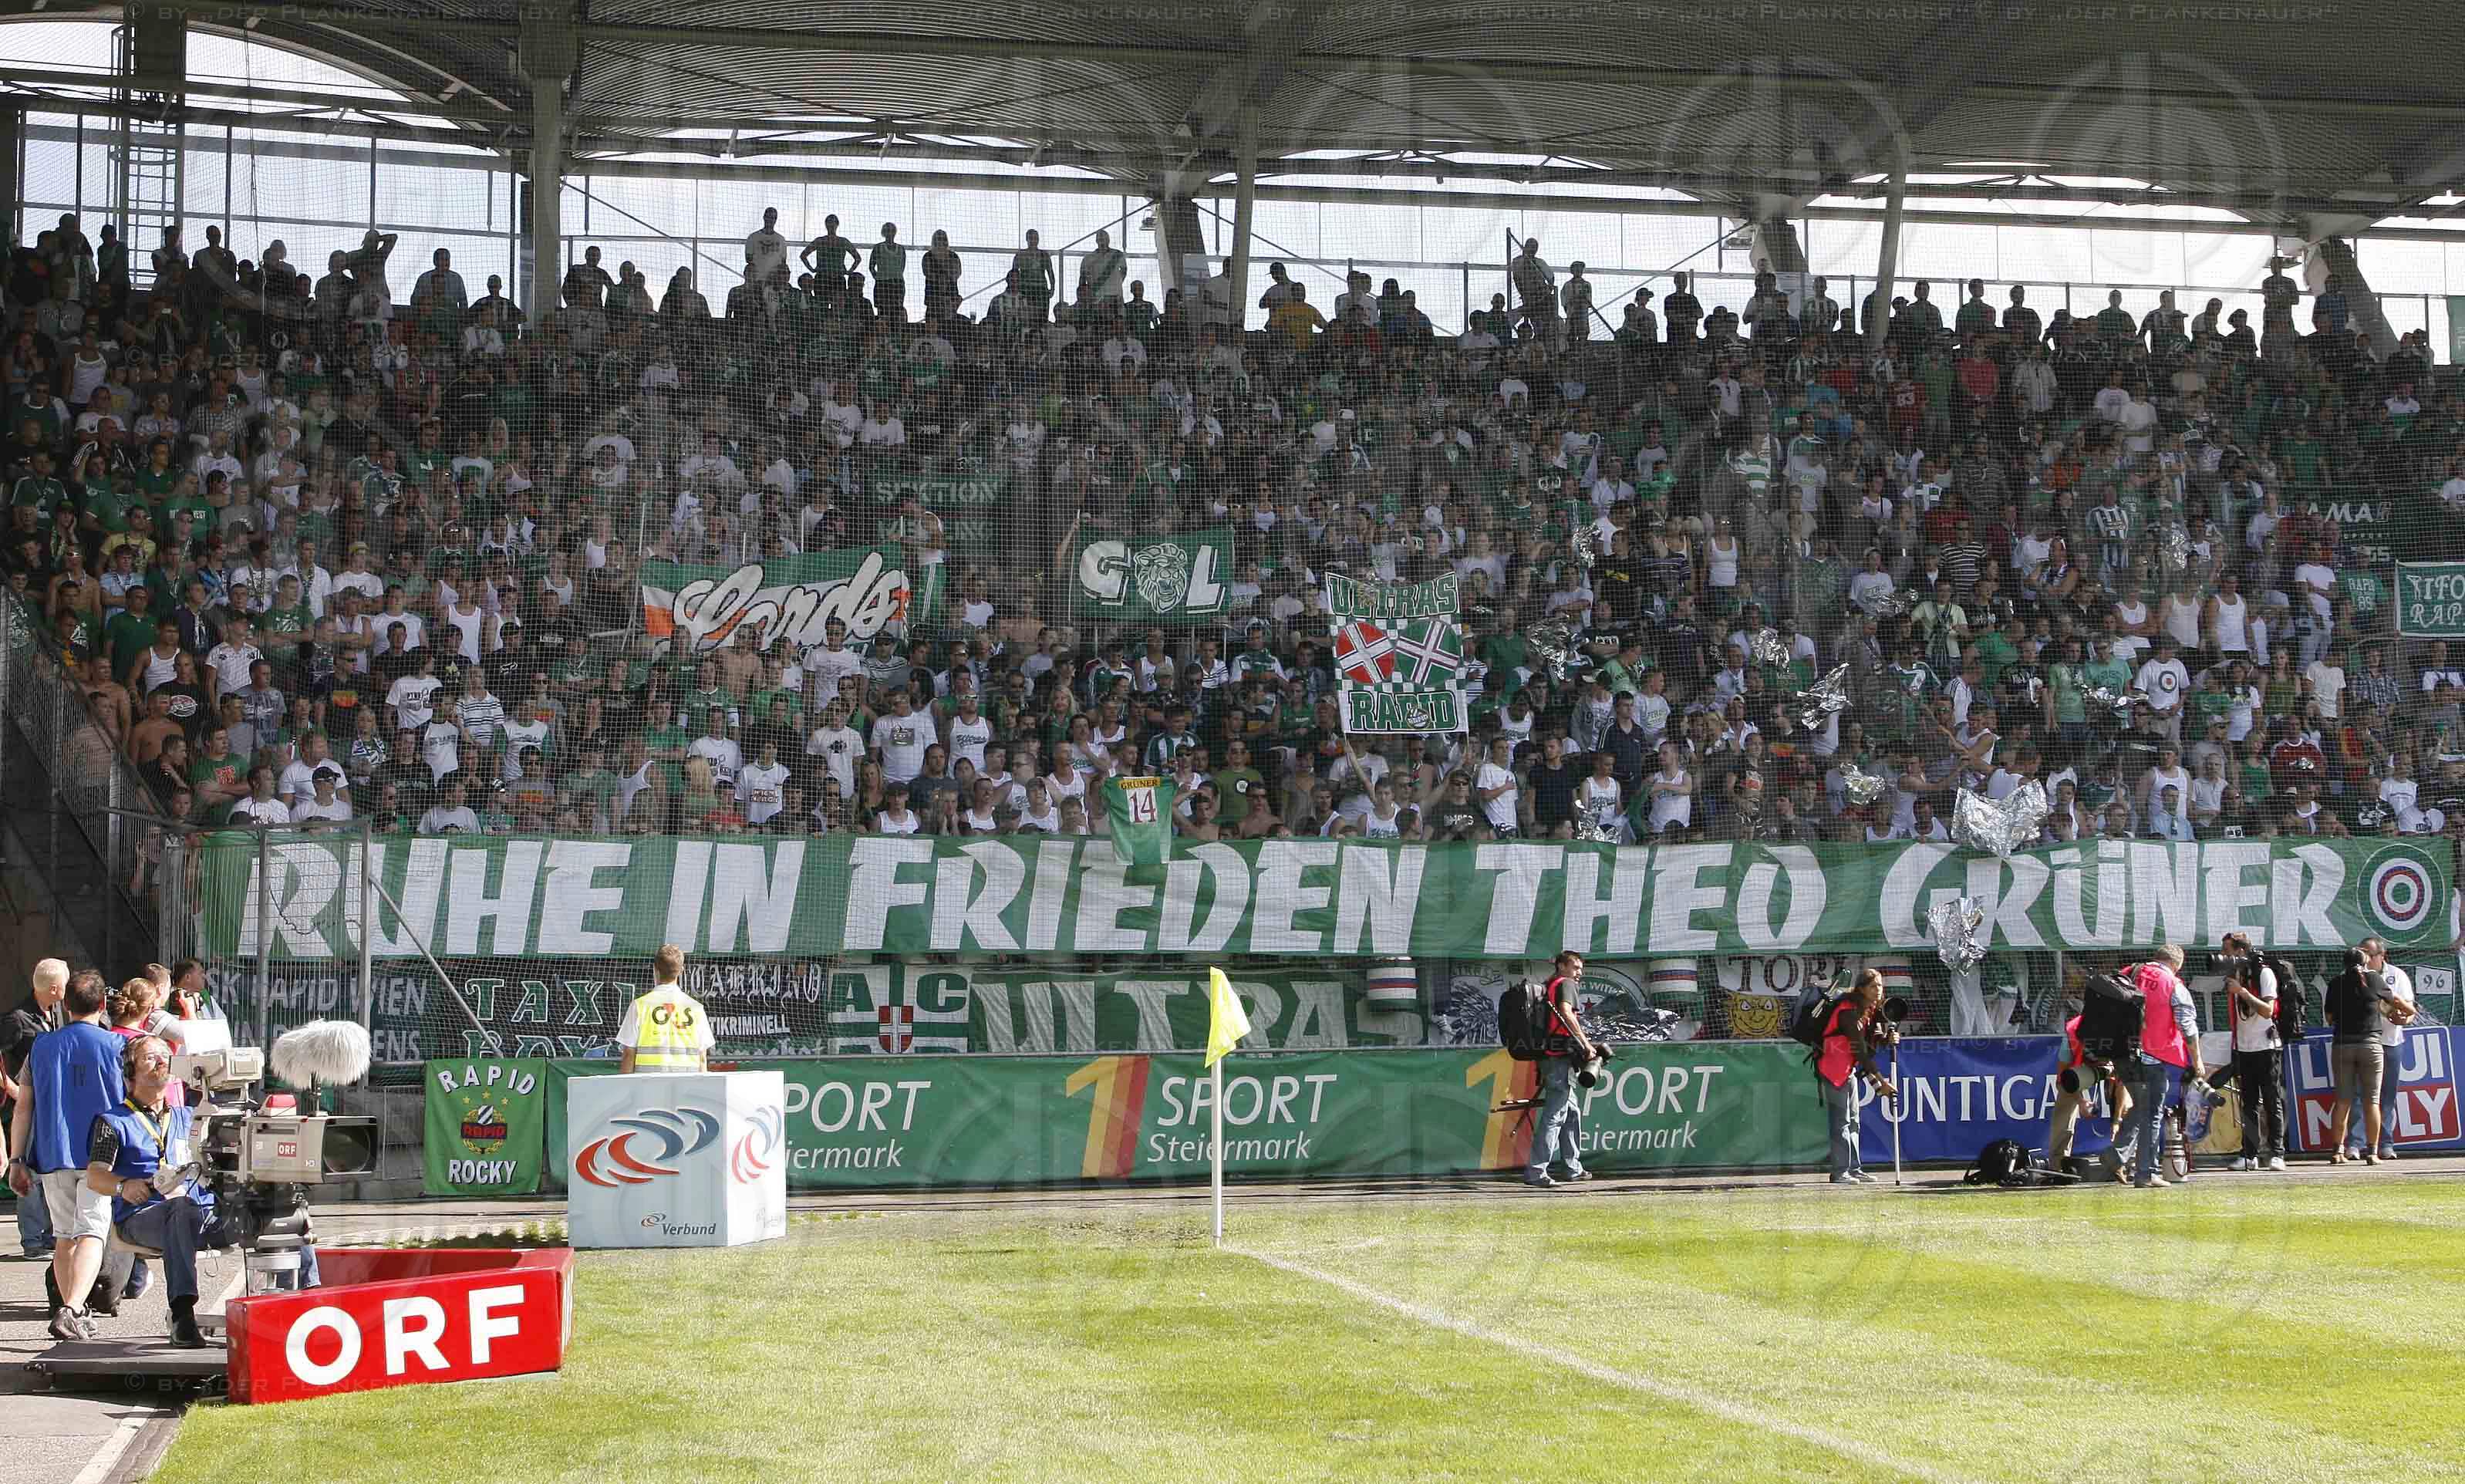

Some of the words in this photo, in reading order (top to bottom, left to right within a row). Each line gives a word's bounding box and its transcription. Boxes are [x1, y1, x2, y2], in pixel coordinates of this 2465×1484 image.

[1329, 576, 1458, 618] ULTRAS
[2410, 603, 2465, 628] RAP
[1349, 691, 1458, 732] RAPID
[1129, 790, 1155, 823] 14
[238, 838, 632, 957] RUHE
[666, 840, 807, 953] IN
[844, 838, 1427, 953] FRIEDEN
[1475, 844, 1826, 954] THEO
[1880, 839, 2346, 946] GRÜNER
[2423, 974, 2445, 989] 96
[708, 1014, 791, 1036] TIKRIMINELL
[2298, 1034, 2443, 1089] LIUI
[438, 1065, 535, 1094] RAPID
[1580, 1066, 1725, 1117] PORT
[784, 1081, 931, 1132] PORT
[1065, 1056, 1149, 1178] 1
[1157, 1074, 1337, 1126] SPORT
[2305, 1088, 2451, 1146] MLY
[278, 1144, 296, 1155] ORF
[1147, 1131, 1311, 1163] Steiermark
[1580, 1122, 1698, 1151] eiermark
[785, 1139, 902, 1169] iermark
[448, 1159, 517, 1185] ROCKY
[663, 1223, 717, 1236] Verbund
[285, 1284, 524, 1387] ORF
